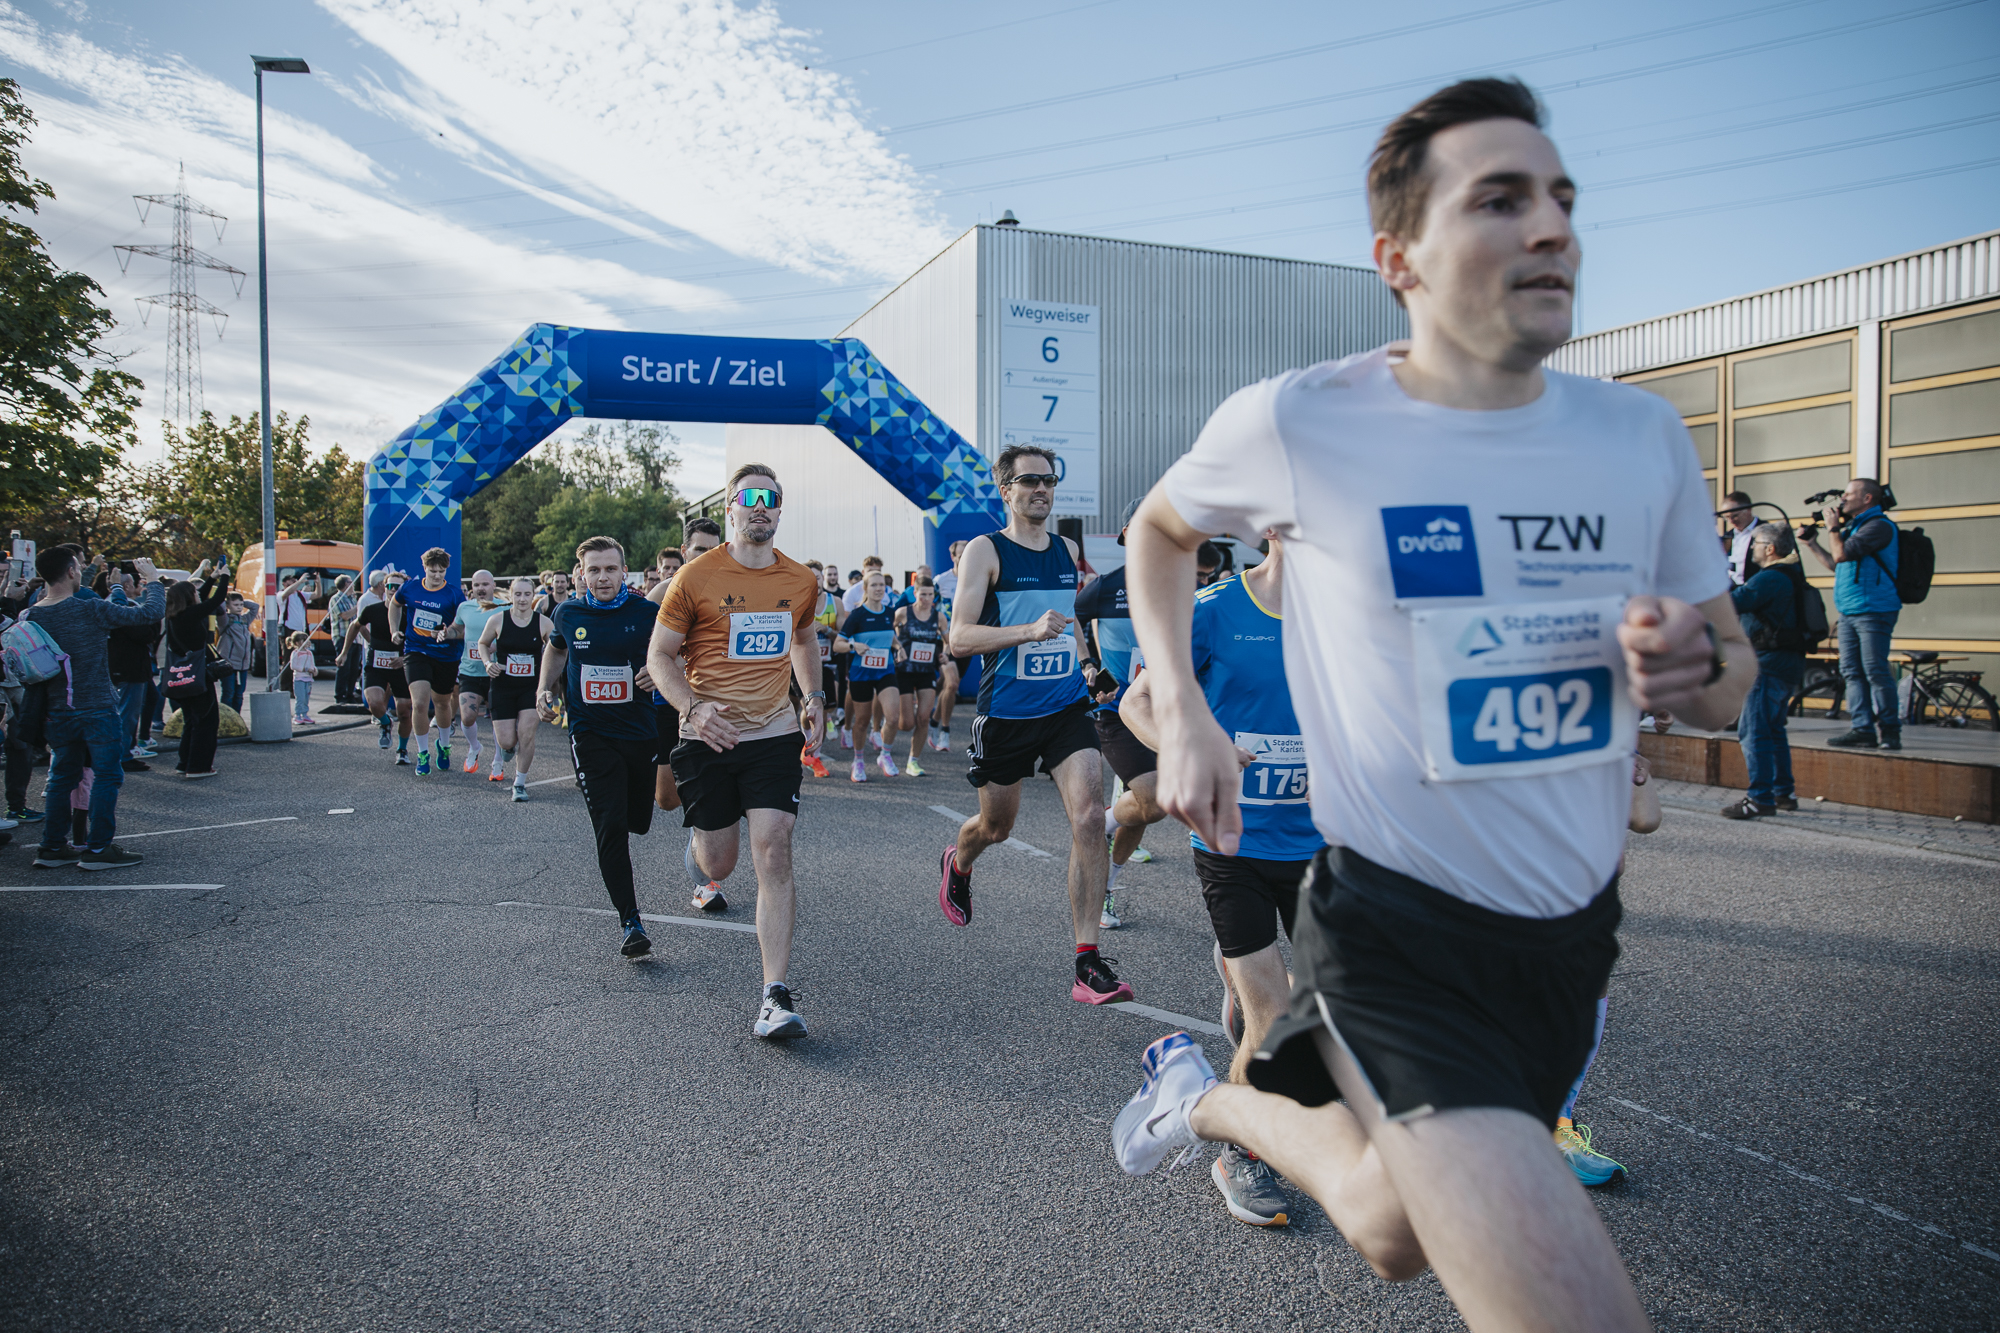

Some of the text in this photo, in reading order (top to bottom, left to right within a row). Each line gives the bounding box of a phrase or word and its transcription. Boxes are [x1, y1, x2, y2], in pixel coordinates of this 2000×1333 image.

[1010, 304, 1091, 323] Wegweiser
[1042, 337, 1059, 363] 6
[622, 355, 786, 387] Start / Ziel
[1033, 376, 1069, 386] Außenlager
[1042, 395, 1059, 422] 7
[1498, 515, 1605, 551] TZW
[1398, 535, 1463, 553] DVGW
[417, 618, 435, 629] 395
[1502, 612, 1600, 631] Stadtwerke
[742, 633, 780, 653] 292
[1523, 628, 1600, 646] Karlsruhe
[511, 664, 530, 675] 872
[1030, 654, 1063, 674] 371
[590, 683, 622, 699] 540
[1473, 679, 1593, 752] 492
[1272, 739, 1304, 747] Stadtwe
[1254, 767, 1308, 795] 175
